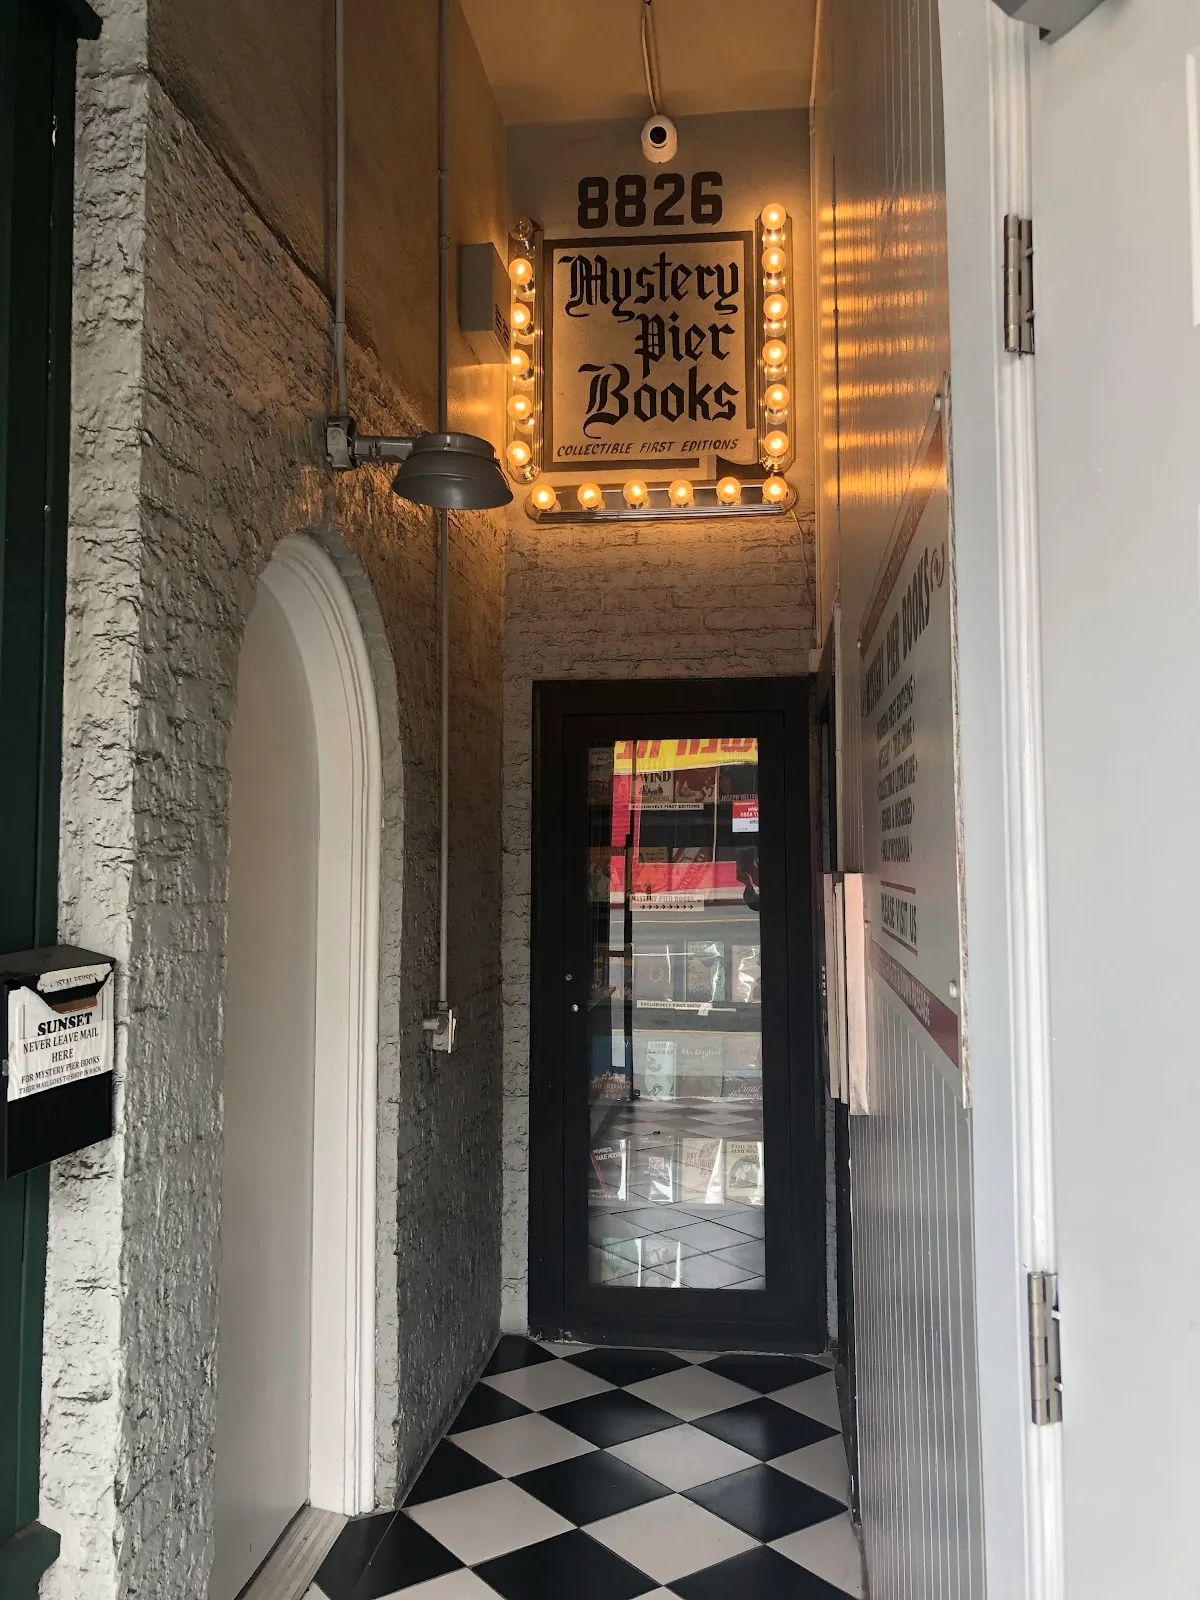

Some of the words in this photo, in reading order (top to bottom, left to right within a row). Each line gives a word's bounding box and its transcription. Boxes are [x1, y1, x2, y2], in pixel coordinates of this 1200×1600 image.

[577, 171, 723, 229] 8826
[557, 251, 739, 323] Mystery
[634, 311, 736, 379] Pier
[577, 363, 740, 439] Books
[557, 442, 632, 457] COLLECTIBLE
[640, 440, 675, 454] FIRST
[681, 438, 739, 452] EDITIONS
[886, 612, 900, 685] PIER
[902, 546, 930, 661] BOOKS
[720, 794, 739, 802] JOSEPH
[909, 904, 917, 945] US
[23, 1037, 51, 1055] NEVER
[53, 1031, 79, 1047] LEAVE
[80, 1027, 99, 1040] MAIL
[37, 1012, 93, 1037] SUNSET
[21, 1073, 34, 1084] FOR
[35, 1065, 65, 1080] MYSTERY
[66, 1061, 79, 1073] PIER
[80, 1055, 100, 1067] BOOKS
[51, 1048, 74, 1063] HERE
